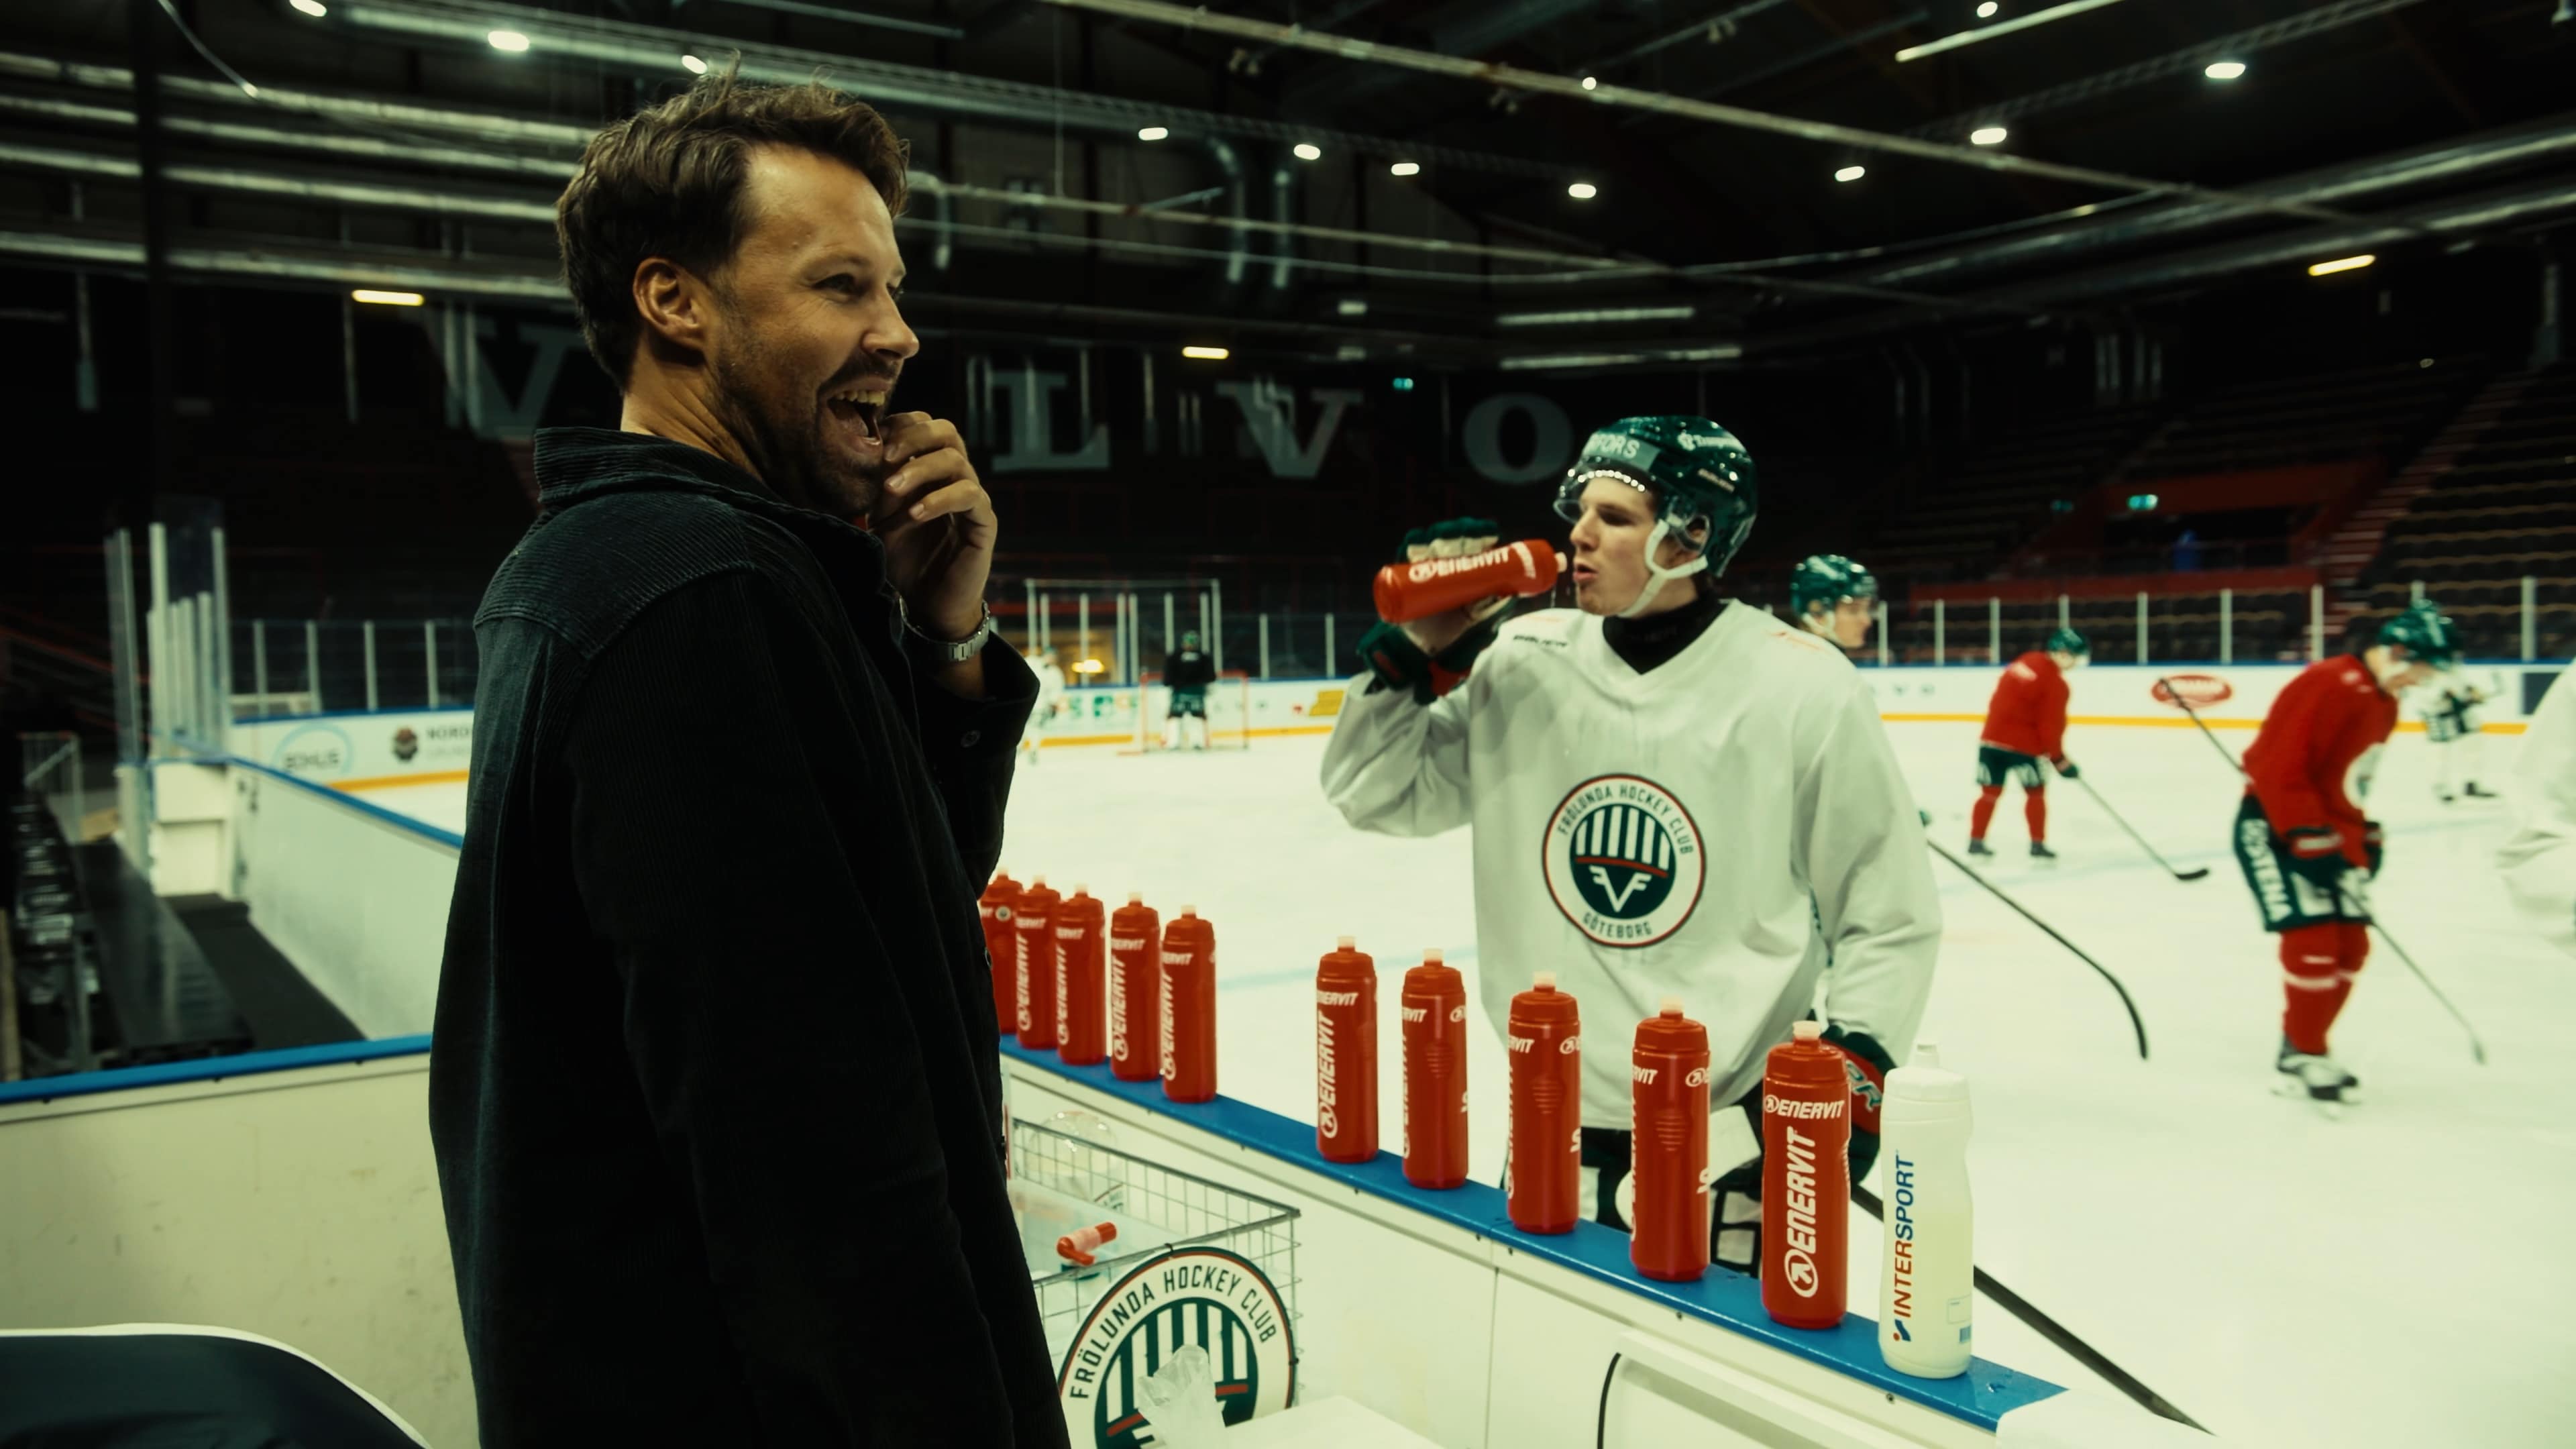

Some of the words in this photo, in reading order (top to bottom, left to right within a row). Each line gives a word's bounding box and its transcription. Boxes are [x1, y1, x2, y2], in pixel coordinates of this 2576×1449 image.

[1438, 547, 1509, 576] ENERVIT
[1619, 784, 1672, 816] HOCKEY
[1668, 816, 1694, 855] CLUB
[1582, 912, 1652, 939] GÖTEBORG
[1318, 1010, 1336, 1108] ENERVIT
[1777, 1099, 1845, 1120] ENERVIT
[1786, 1126, 1816, 1254] ENERVIT
[1894, 1155, 1914, 1318] INTERSPORT
[1070, 1282, 1155, 1399] FRÖLUNDA
[1163, 1265, 1242, 1297] HOCKEY
[1240, 1289, 1277, 1343] CLUB
